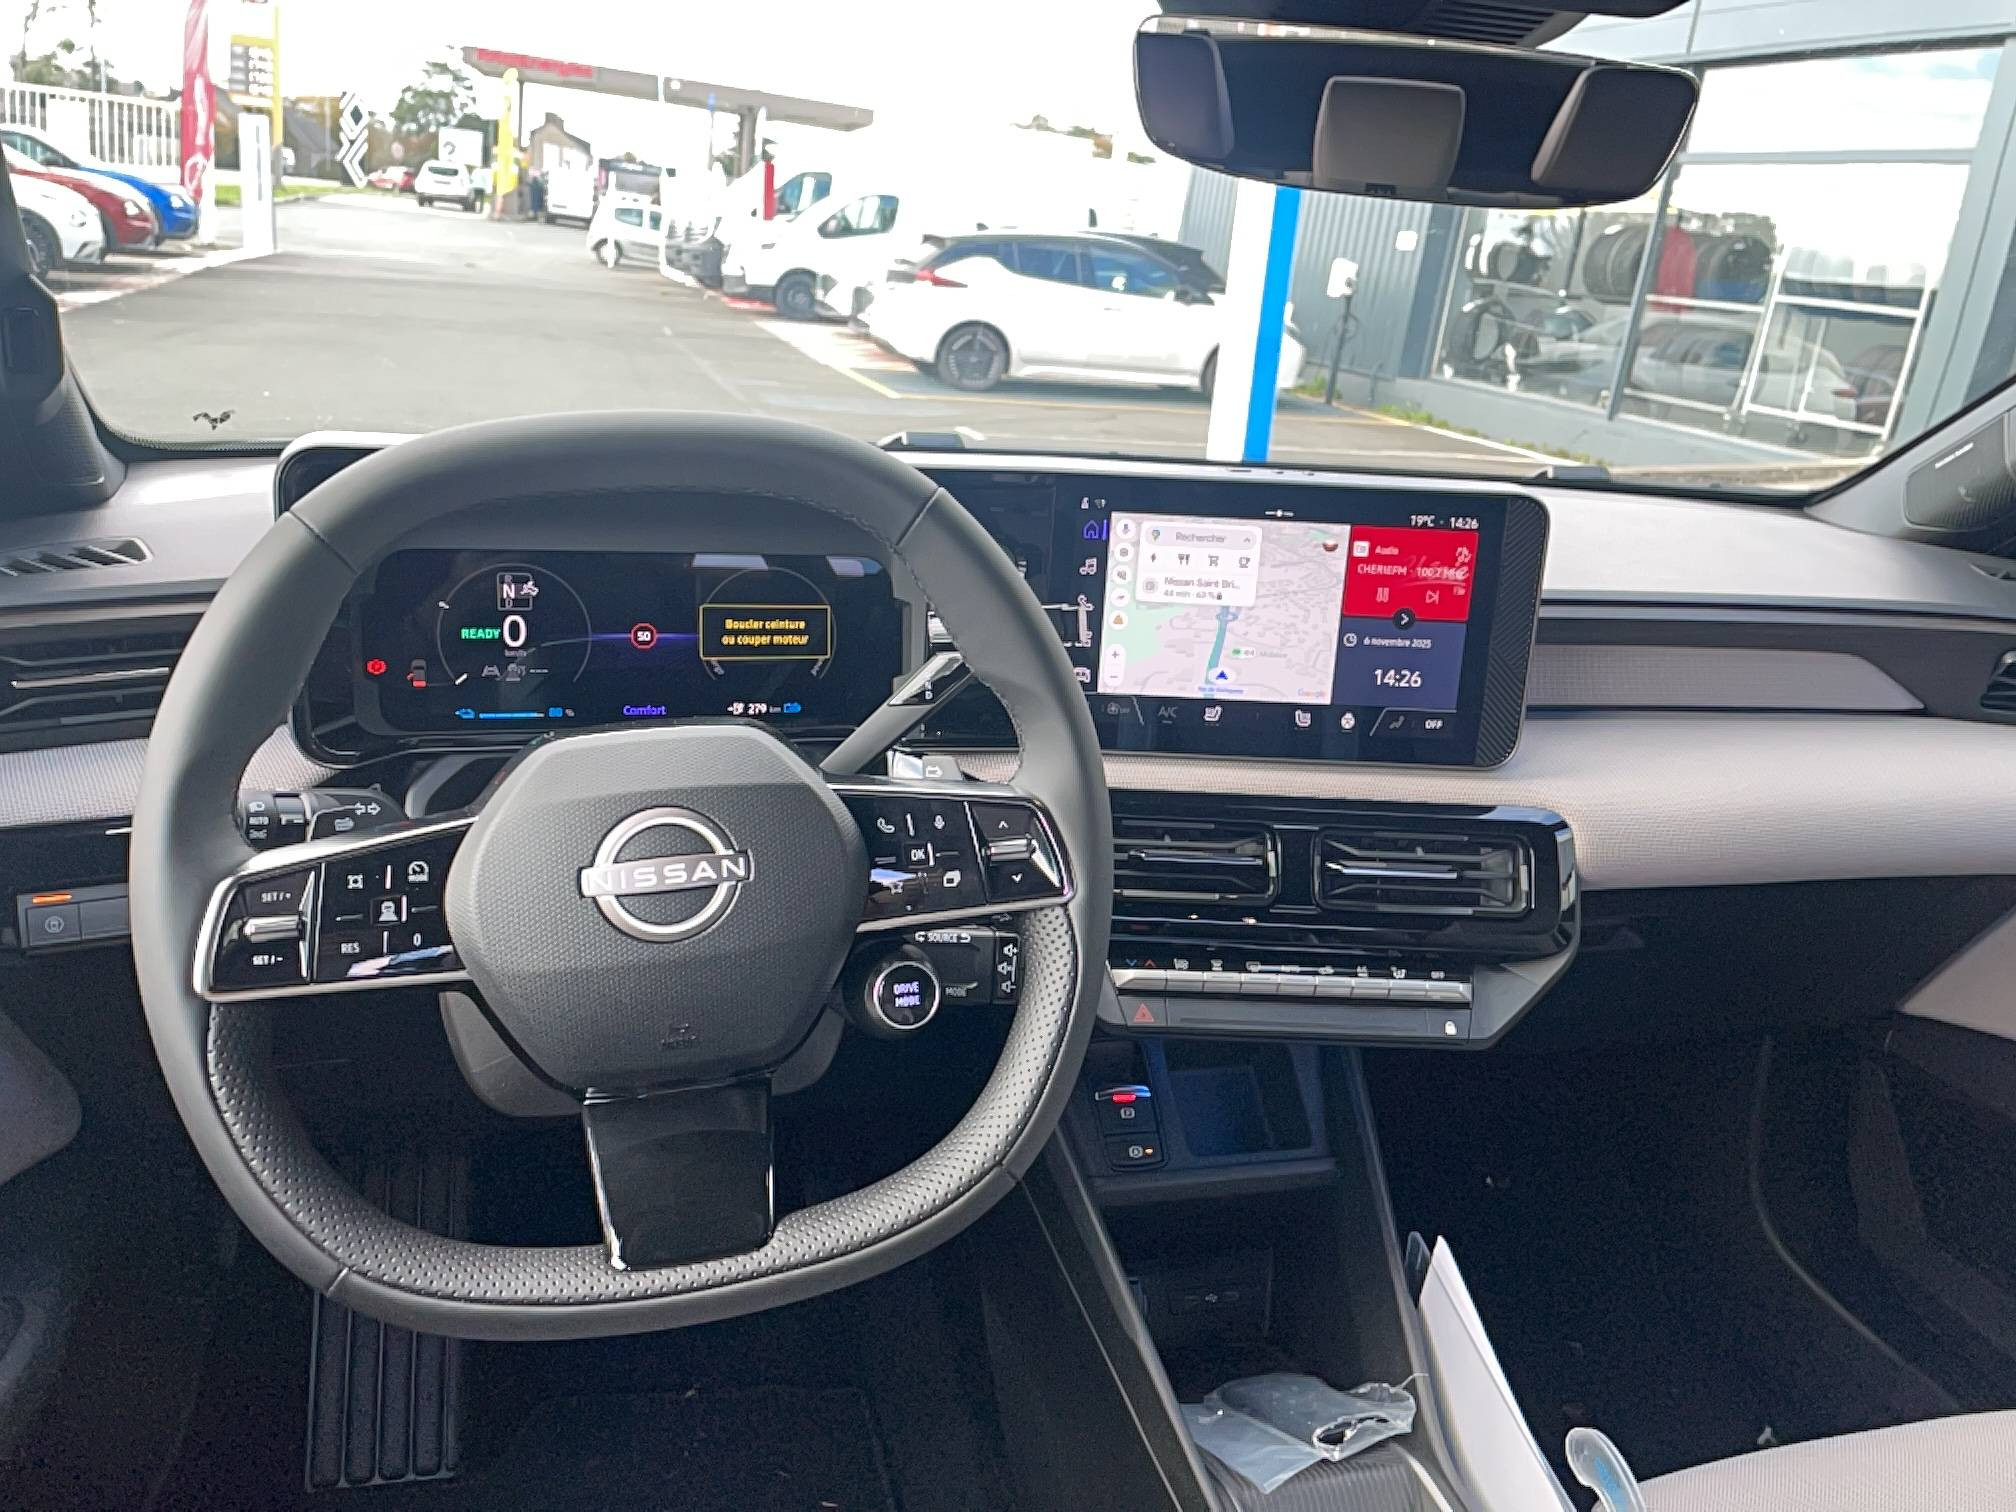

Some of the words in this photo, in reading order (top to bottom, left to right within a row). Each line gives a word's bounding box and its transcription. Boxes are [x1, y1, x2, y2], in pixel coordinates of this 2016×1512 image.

[1449, 516, 1480, 529] 14:26
[1175, 531, 1226, 543] Rechercher
[1375, 545, 1399, 555] Audio
[503, 583, 516, 599] N
[460, 626, 501, 640] READY
[503, 614, 528, 648] 0
[724, 619, 764, 630] Boucler
[765, 619, 806, 630] ceinture
[636, 630, 652, 642] 50
[721, 635, 736, 646] ou
[737, 634, 771, 647] couper
[772, 634, 810, 646] moteur
[1371, 638, 1410, 648] novembre
[1411, 639, 1432, 649] 2025
[1374, 668, 1422, 688] 14:26
[623, 704, 667, 716] Comfort
[747, 702, 768, 715] 279
[1158, 705, 1178, 718] A/C
[1424, 718, 1444, 731] OFF
[248, 815, 270, 826] AUTO
[910, 848, 926, 861] OK
[587, 856, 746, 892] NISSAN
[926, 932, 959, 943] SOURCE
[340, 942, 361, 954] RES
[892, 980, 921, 996] DRIVE
[894, 993, 922, 1008] MODE
